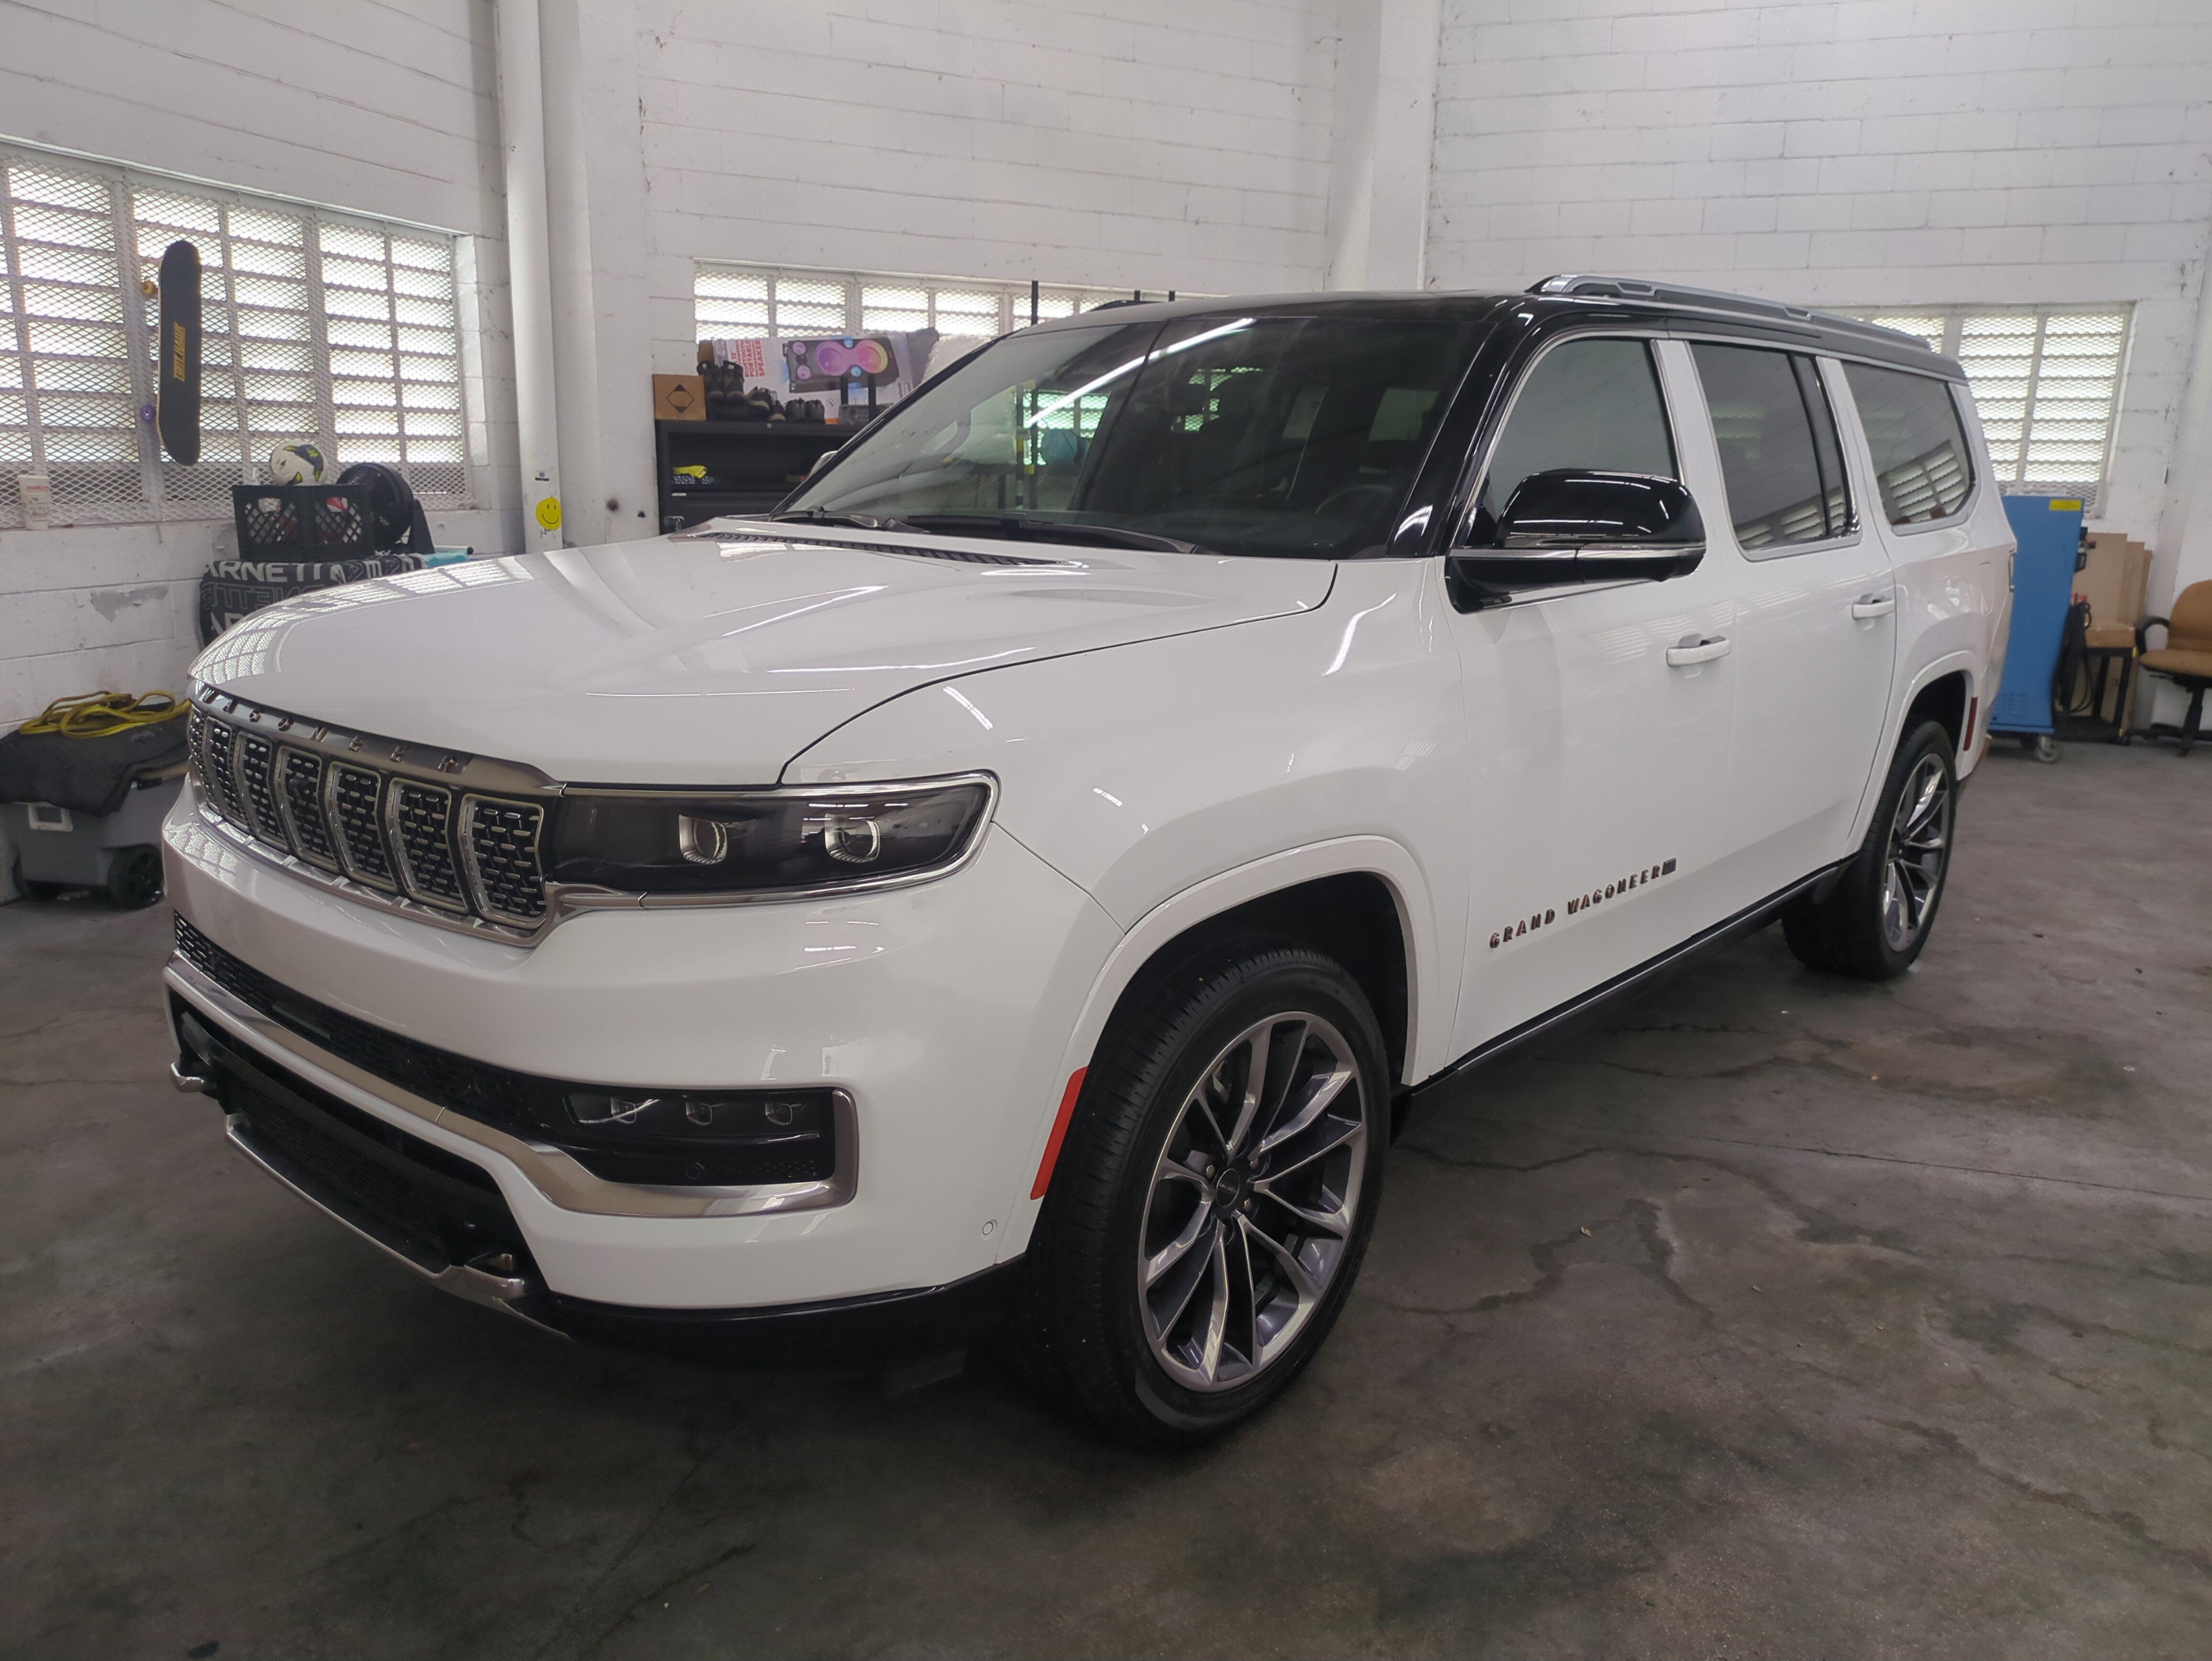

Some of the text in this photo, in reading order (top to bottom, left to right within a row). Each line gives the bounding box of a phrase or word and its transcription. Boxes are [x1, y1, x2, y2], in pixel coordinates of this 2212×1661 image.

[745, 340, 755, 377] PORTABLE
[755, 340, 765, 377] SPEAKER
[199, 687, 458, 774] WAGONEER
[1489, 865, 1660, 949] GRAND WAGONEER
